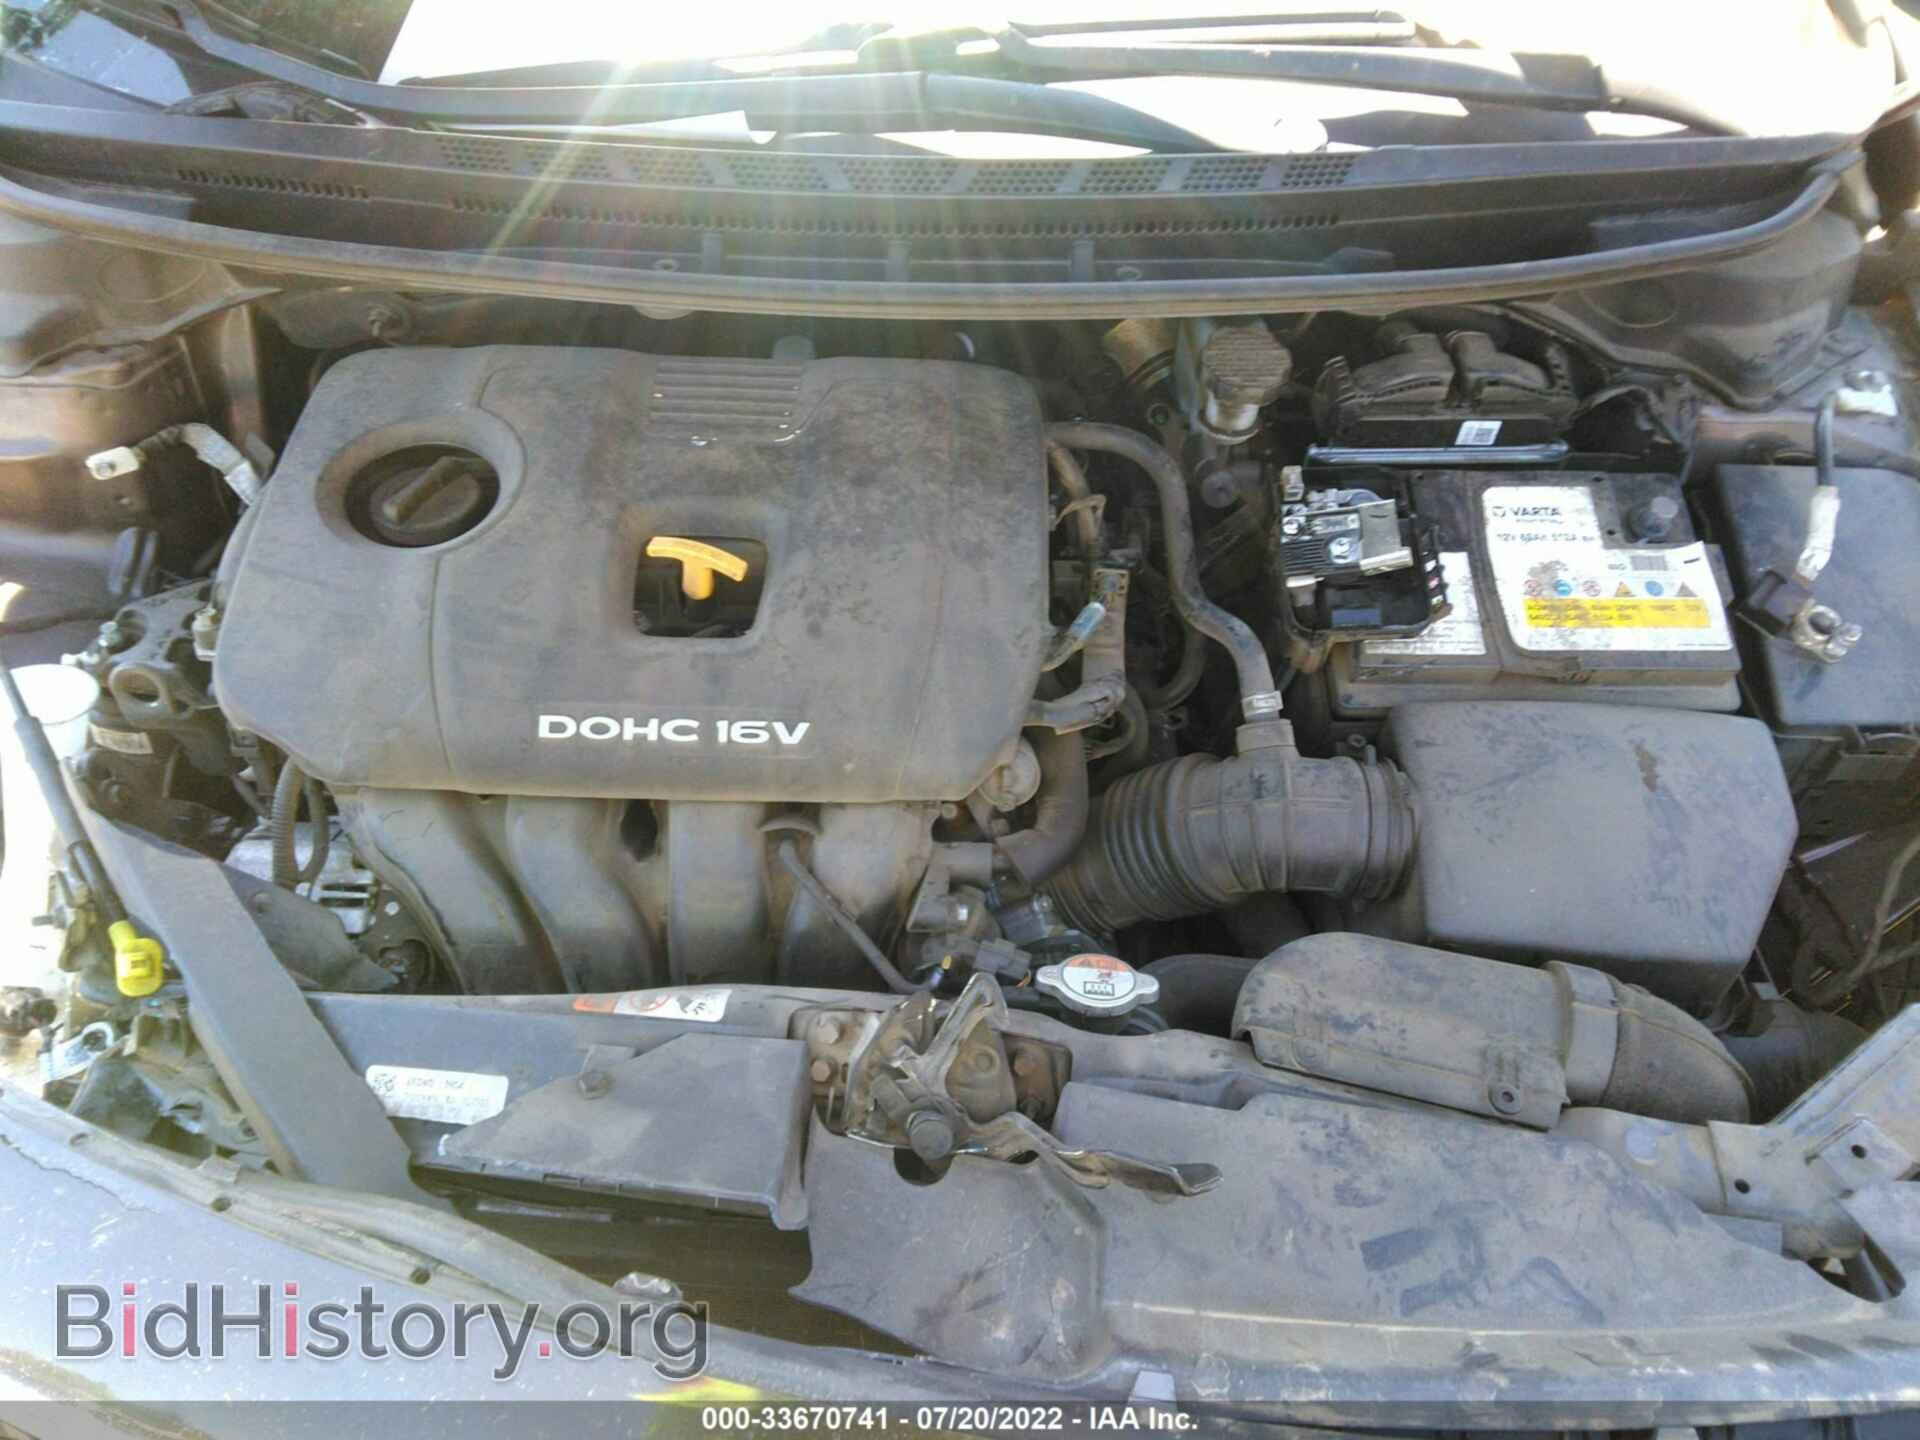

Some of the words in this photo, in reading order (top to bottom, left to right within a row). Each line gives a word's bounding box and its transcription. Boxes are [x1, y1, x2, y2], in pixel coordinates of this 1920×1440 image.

[1511, 506, 1561, 516] VARTA
[538, 714, 700, 742] DOHC
[715, 719, 811, 745] 16V
